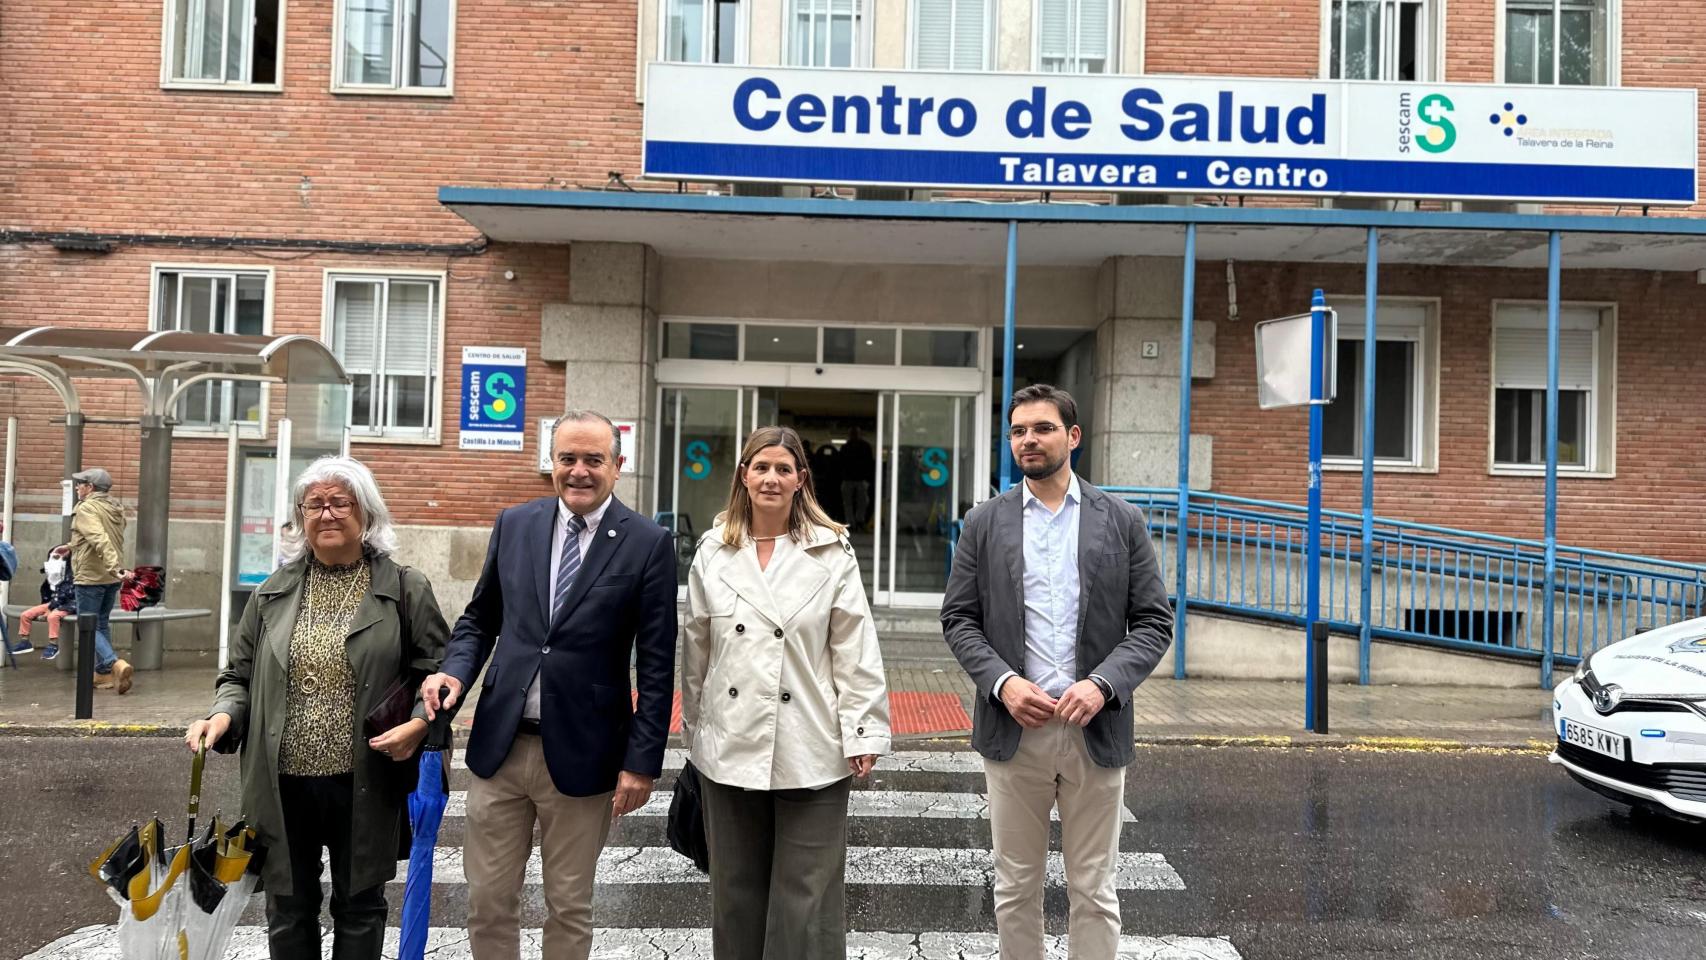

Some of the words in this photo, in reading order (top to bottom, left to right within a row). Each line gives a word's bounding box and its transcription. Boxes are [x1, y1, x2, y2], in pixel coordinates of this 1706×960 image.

[732, 77, 977, 138] Centro
[1005, 86, 1092, 140] de
[1119, 87, 1327, 146] Salud
[1399, 92, 1411, 153] sescam
[1516, 136, 1559, 148] Talavera
[1560, 139, 1574, 148] de
[1575, 139, 1584, 148] la
[1585, 139, 1614, 149] Reina
[999, 157, 1157, 184] Talavera
[1206, 160, 1328, 188] Centro
[1146, 343, 1154, 355] 2
[469, 371, 481, 421] sescam
[496, 438, 521, 447] Mancha
[1567, 723, 1594, 747] 6585
